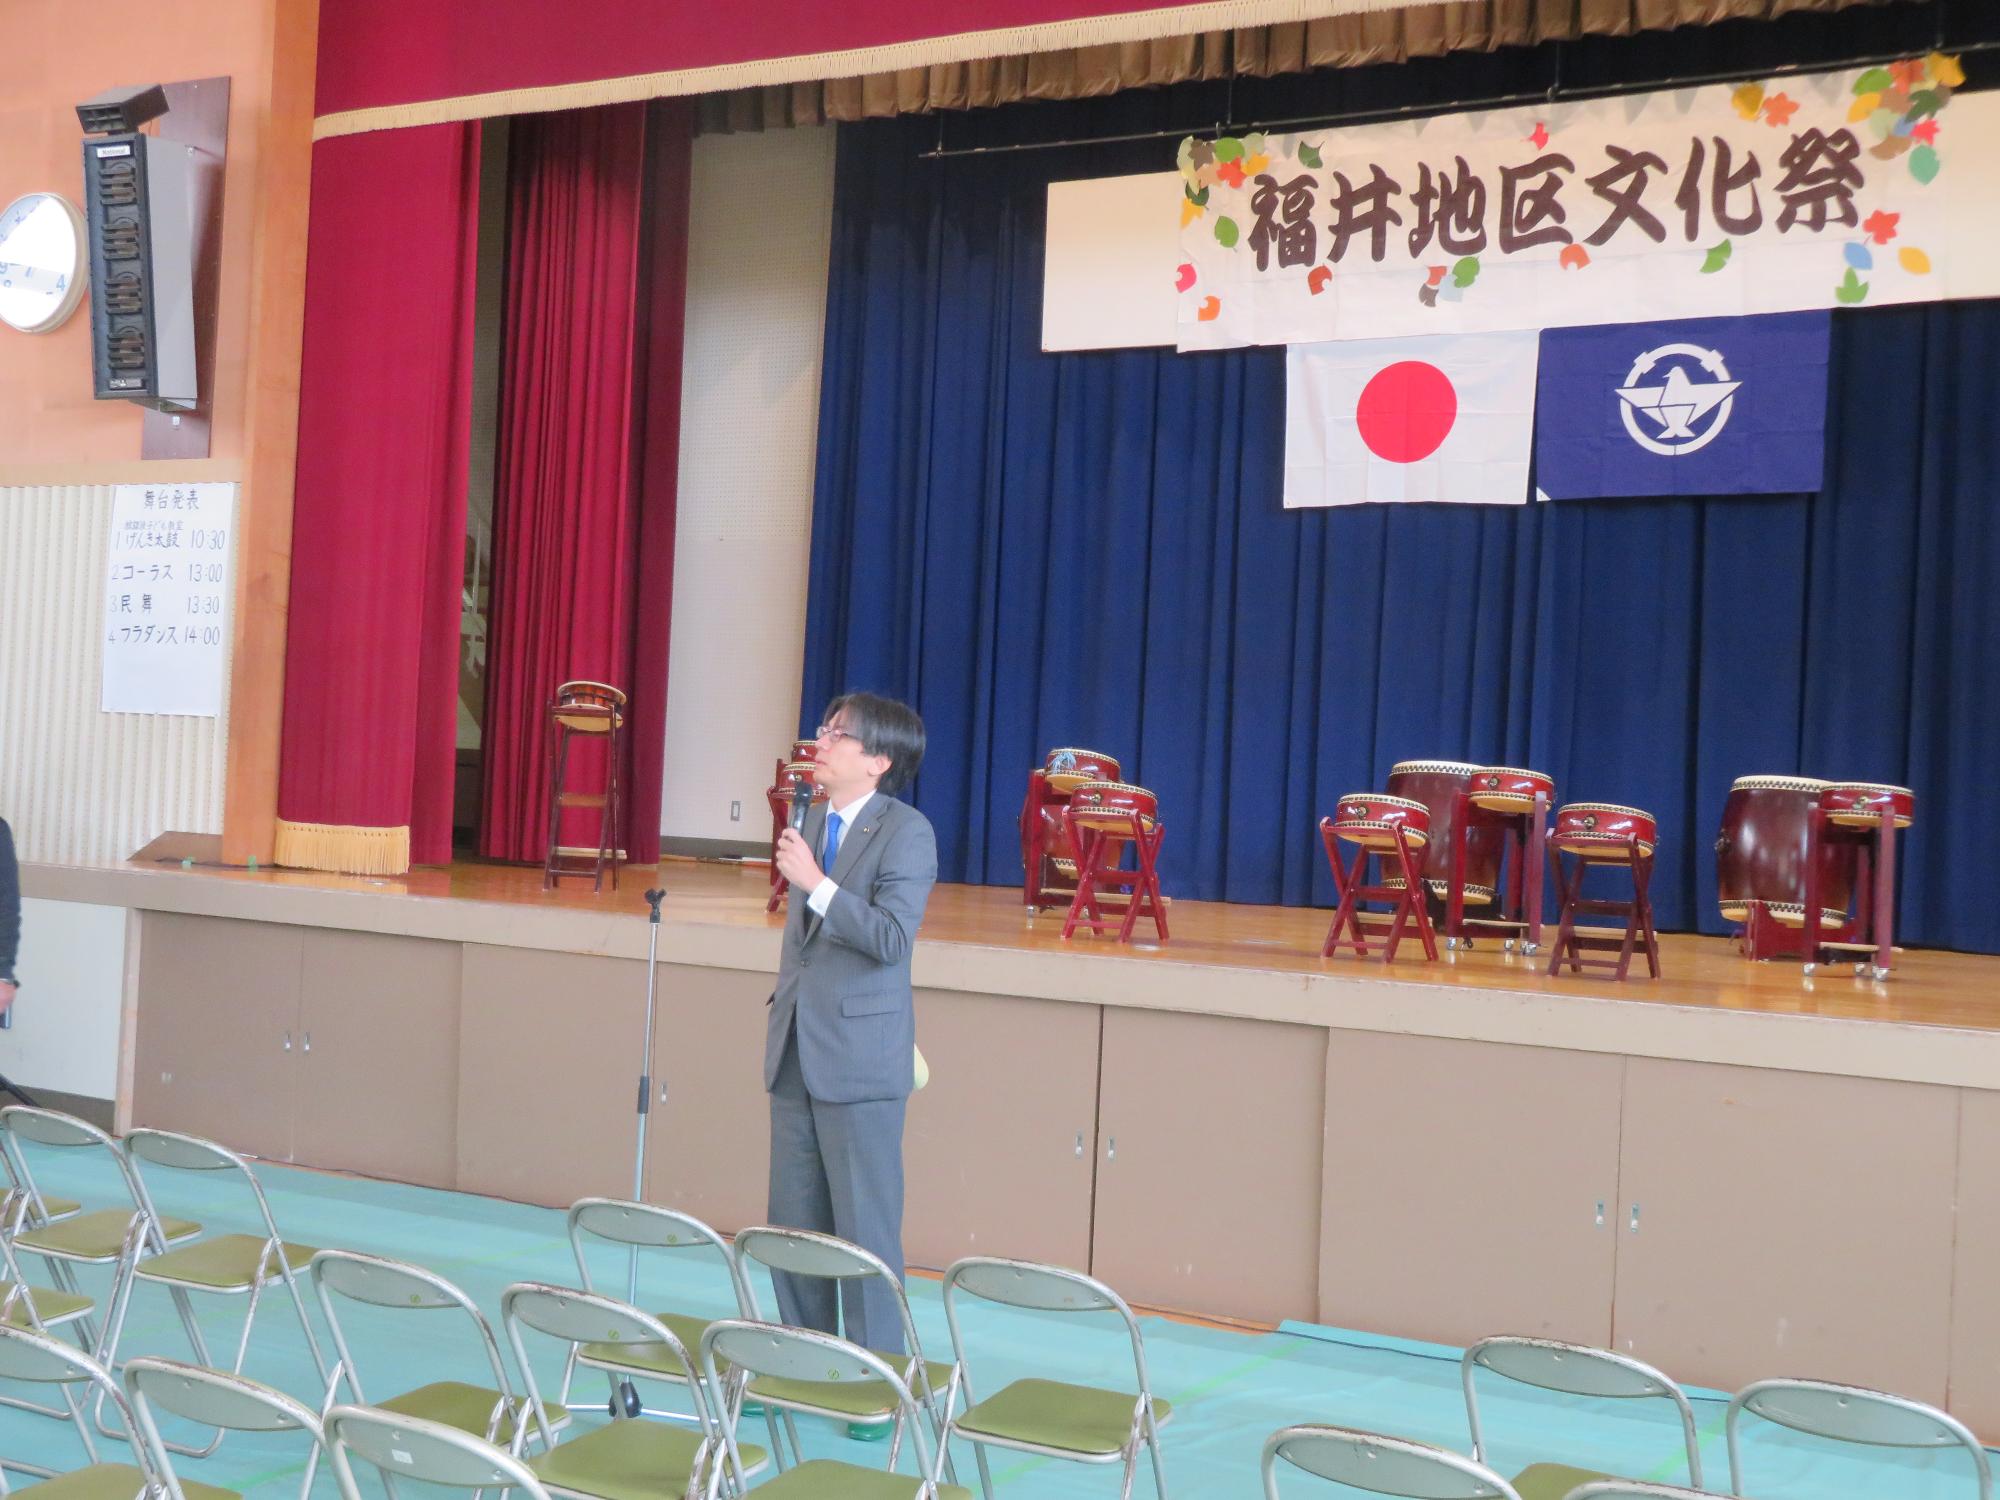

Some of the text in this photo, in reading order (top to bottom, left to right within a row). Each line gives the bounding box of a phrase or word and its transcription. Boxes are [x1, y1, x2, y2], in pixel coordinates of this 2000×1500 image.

[1248, 127, 1865, 272] 福井地区文化祭
[143, 489, 200, 510] 舞台発表
[125, 531, 180, 550] げんき太鼓
[191, 529, 226, 550] 10:30
[122, 564, 174, 581] コーラス
[188, 563, 223, 583] 13:00
[186, 595, 220, 614] 13:30
[120, 625, 179, 645] フラダンス
[184, 625, 221, 646] 14:00
